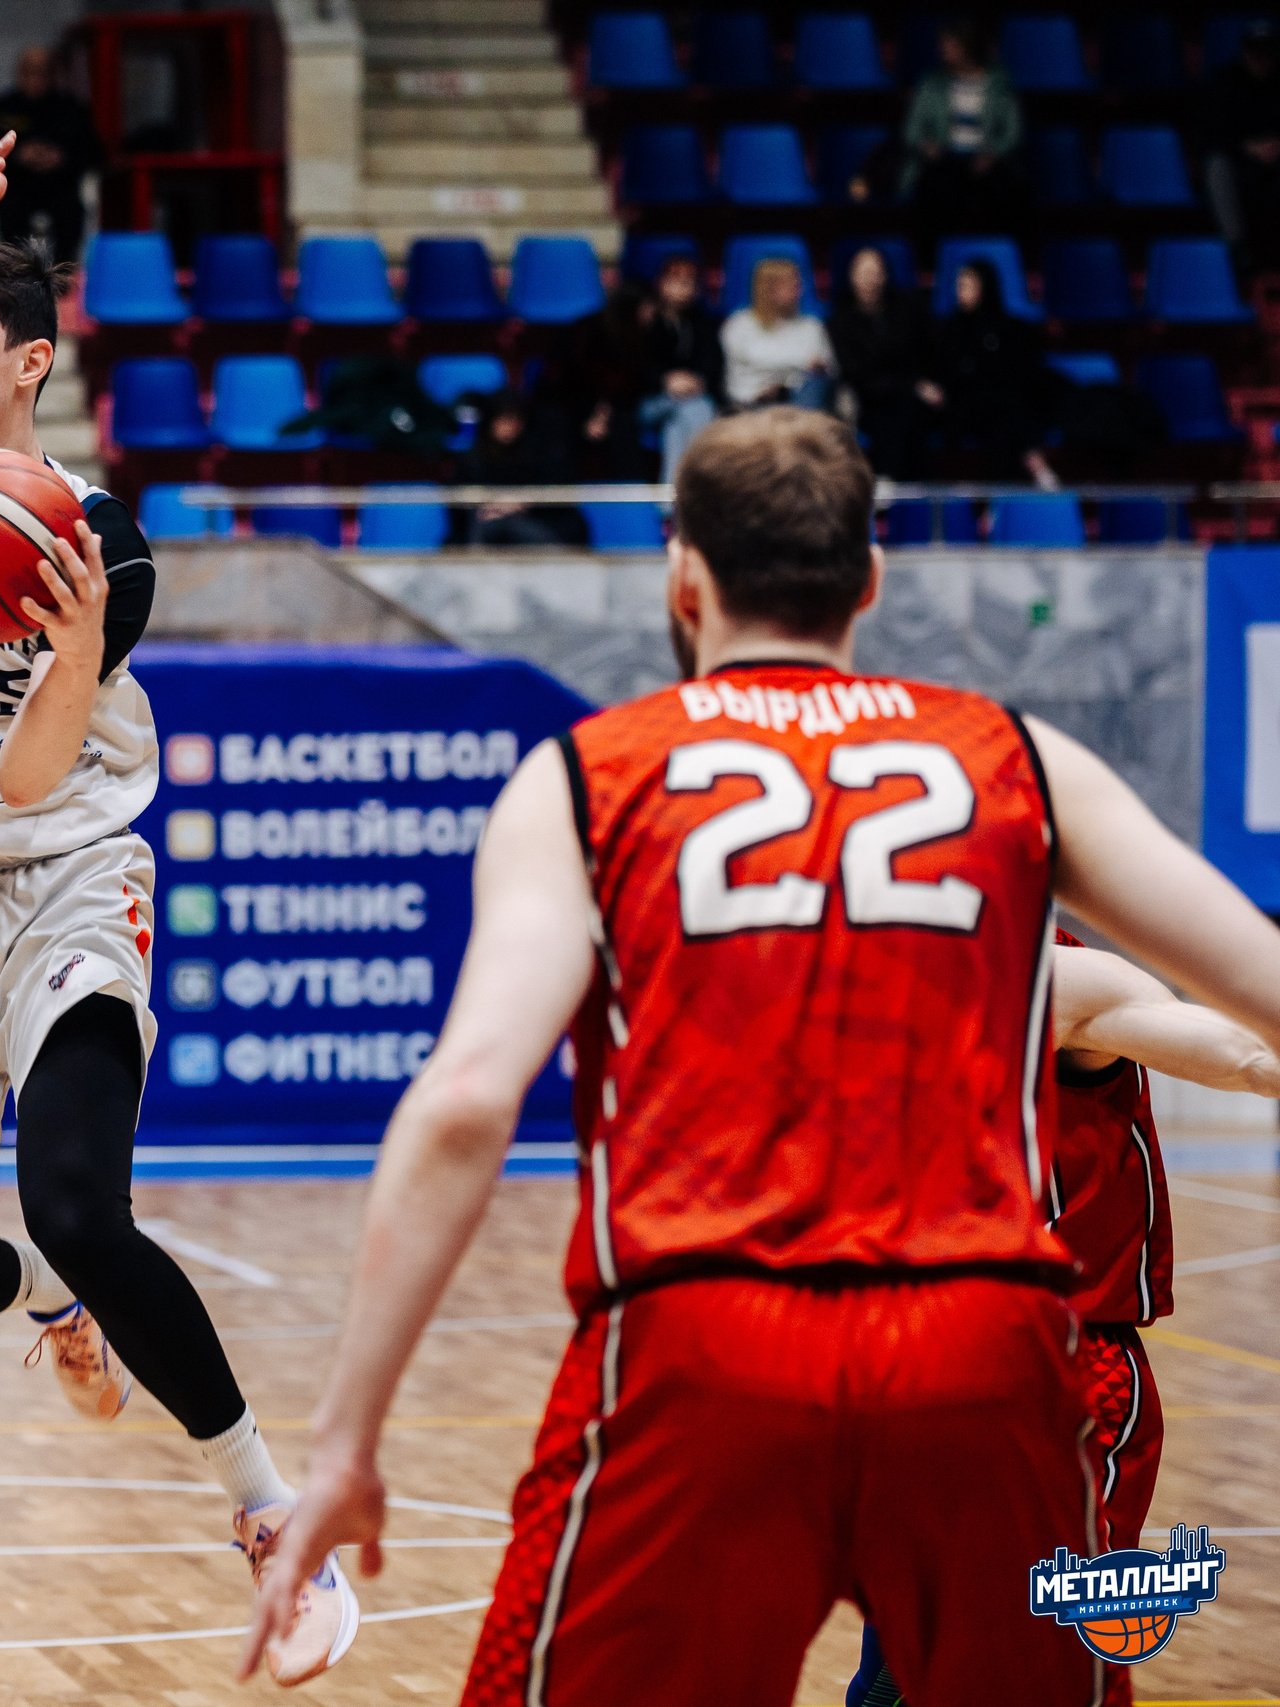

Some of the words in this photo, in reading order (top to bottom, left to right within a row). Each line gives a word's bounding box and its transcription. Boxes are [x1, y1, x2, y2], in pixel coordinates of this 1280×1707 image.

[677, 680, 917, 738] БЫРДИН
[219, 730, 520, 784] БАСКЕТБОЛ
[221, 799, 489, 860] ВОЛЕЙБОЛ
[665, 739, 985, 944] 22
[222, 882, 427, 934] ТЕННИС
[222, 957, 434, 1009] ФУТБОЛ
[224, 1032, 437, 1083] ФИТНЕС
